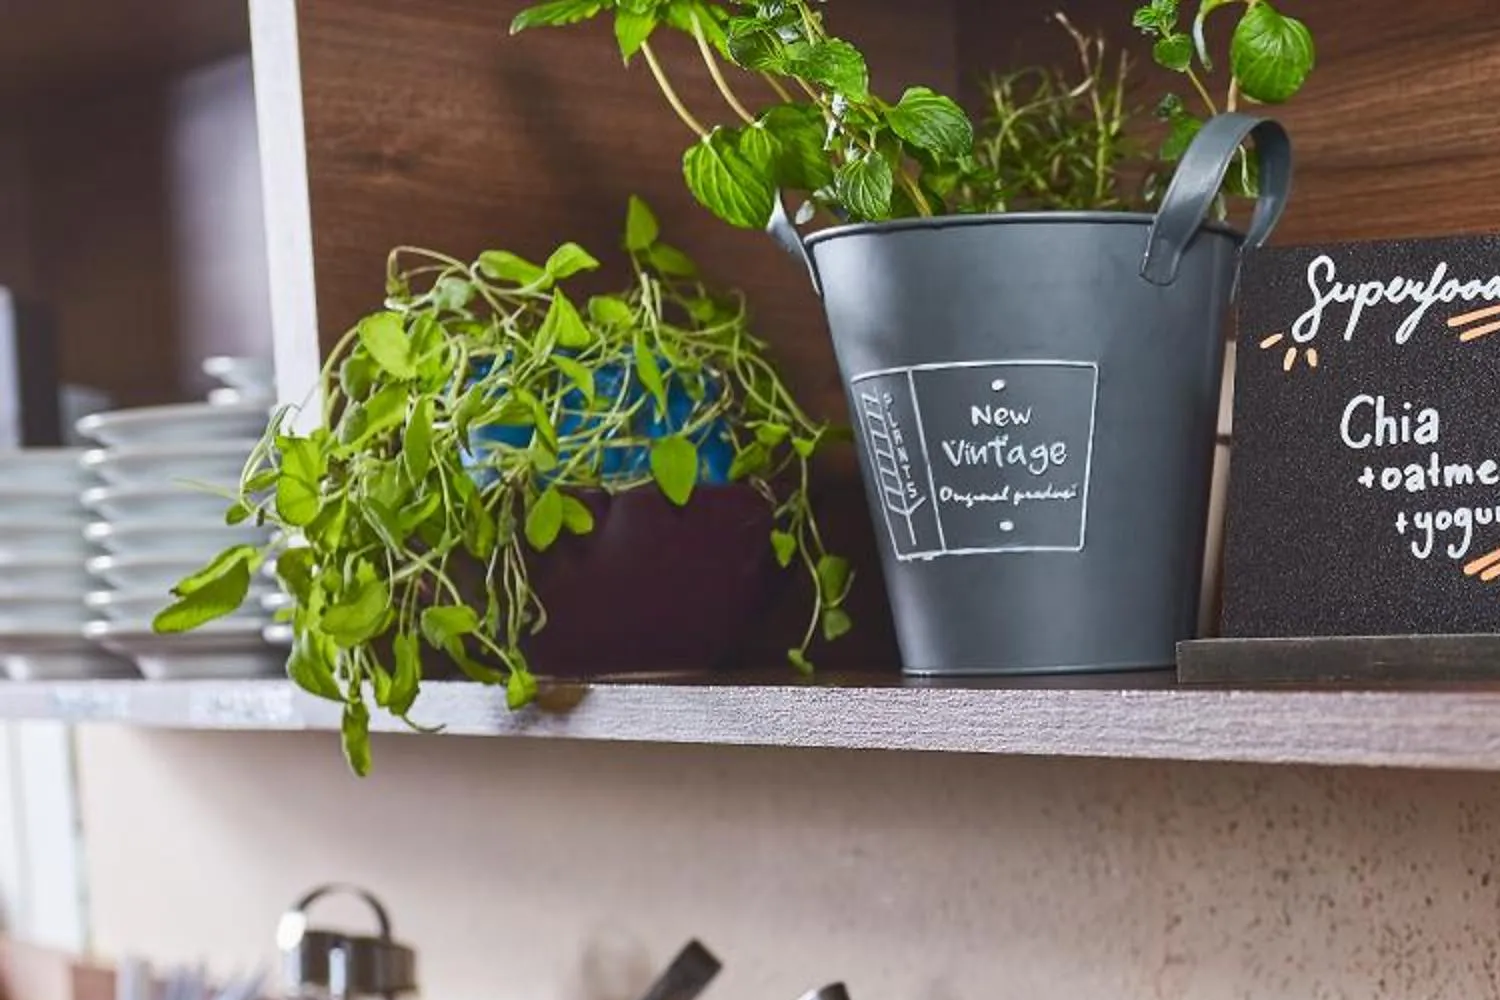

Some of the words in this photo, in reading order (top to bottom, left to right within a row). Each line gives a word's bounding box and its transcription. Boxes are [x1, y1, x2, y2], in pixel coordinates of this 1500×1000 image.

[970, 403, 1032, 427] New
[1339, 394, 1440, 449] Chia
[941, 433, 1068, 475] Vintage
